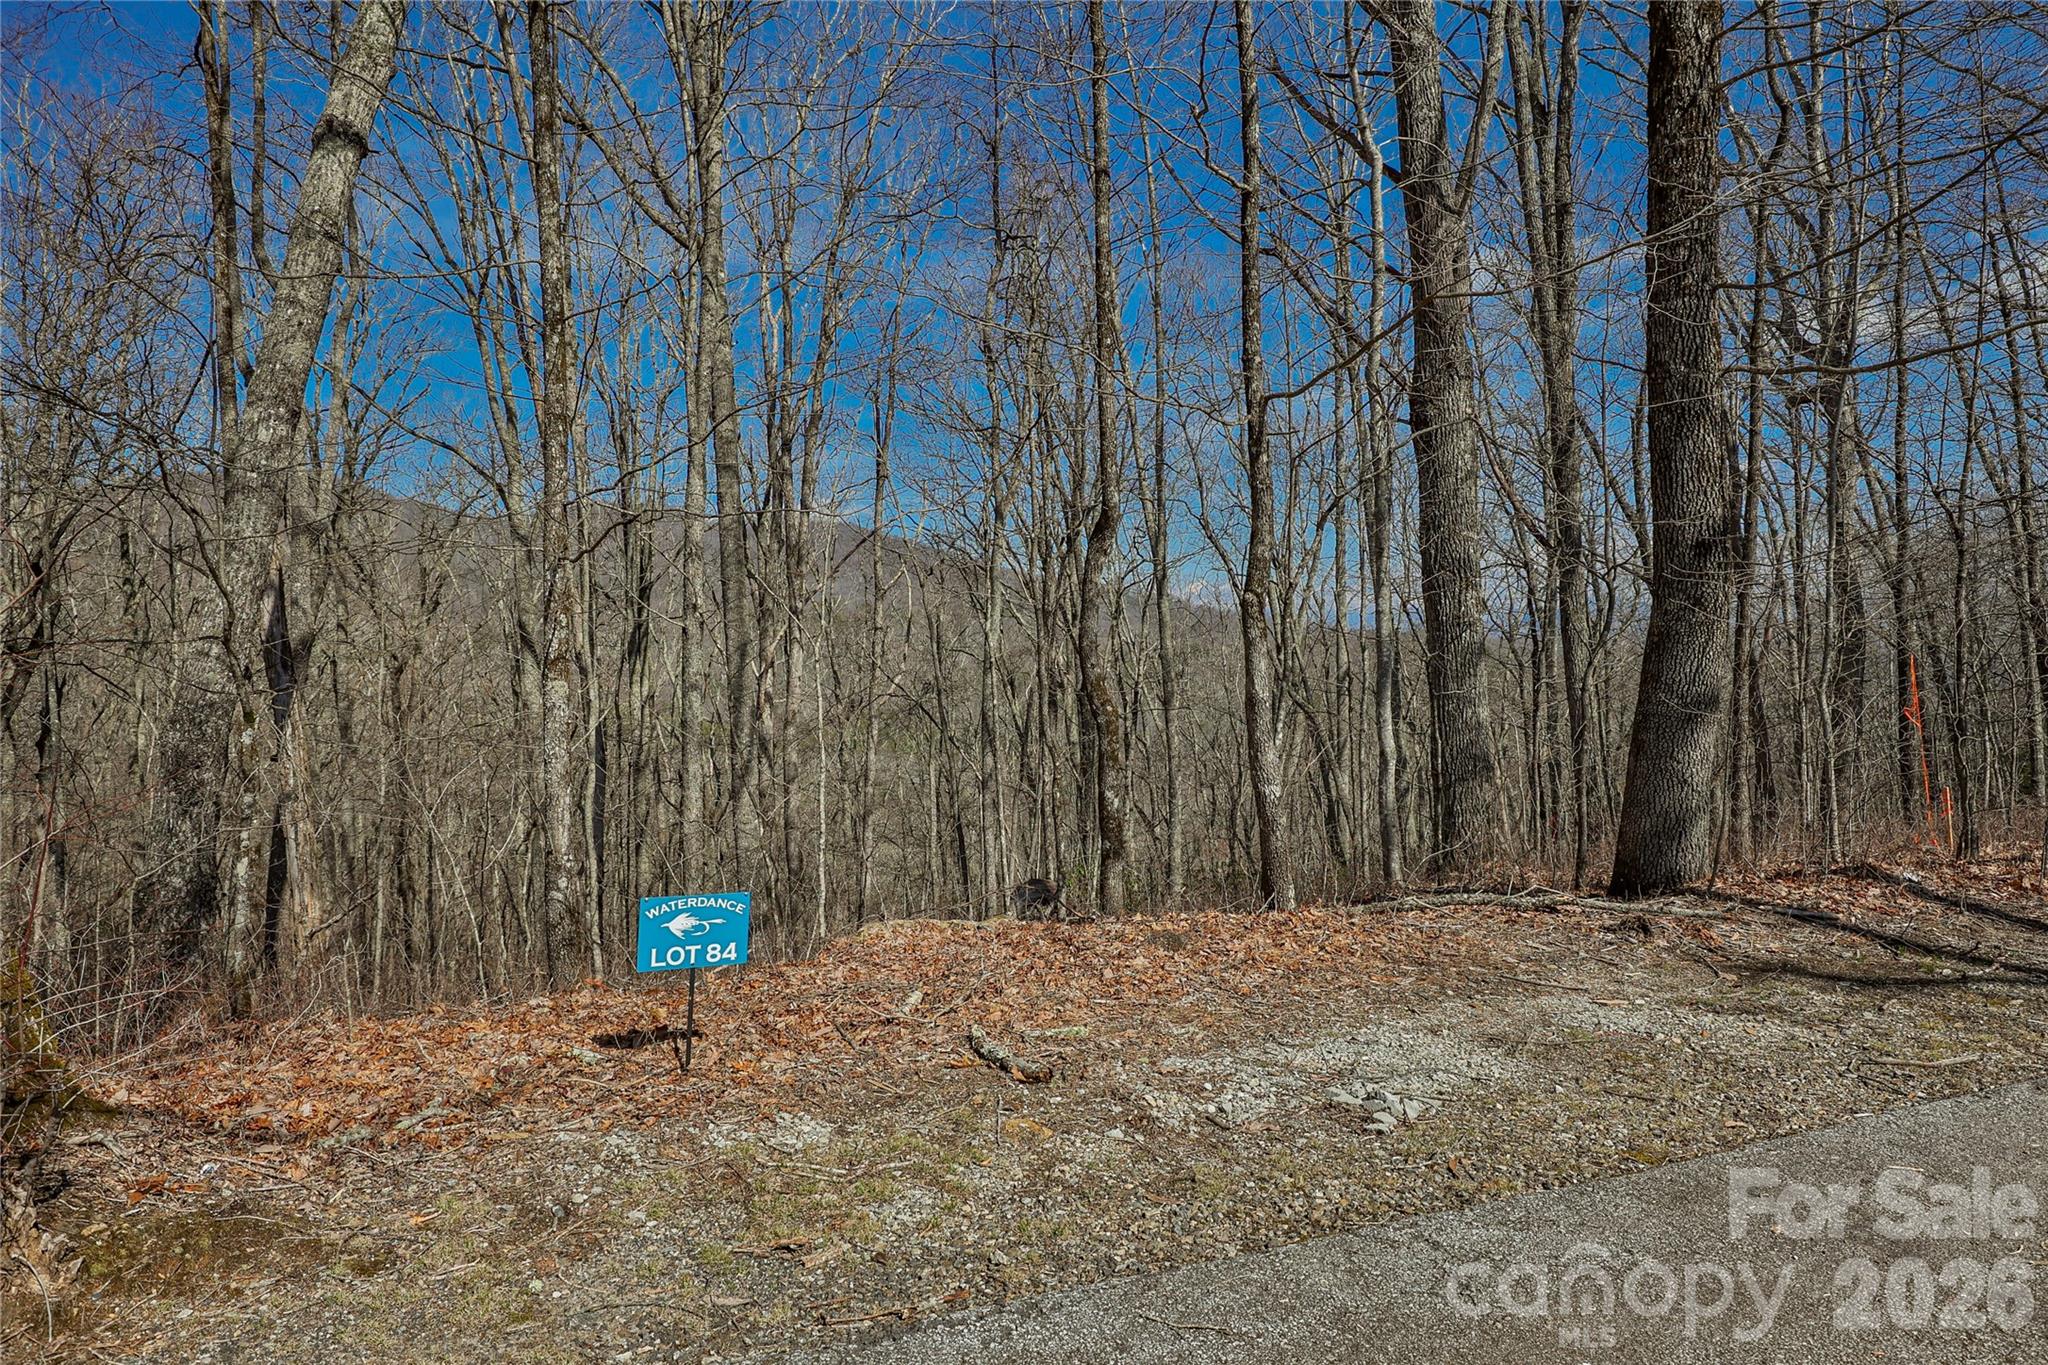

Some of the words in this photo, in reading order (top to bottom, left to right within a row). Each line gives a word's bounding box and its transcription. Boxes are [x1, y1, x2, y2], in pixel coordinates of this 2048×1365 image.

[645, 897, 746, 918] WATERDANCE
[651, 945, 702, 967] LOT
[706, 942, 737, 963] 84
